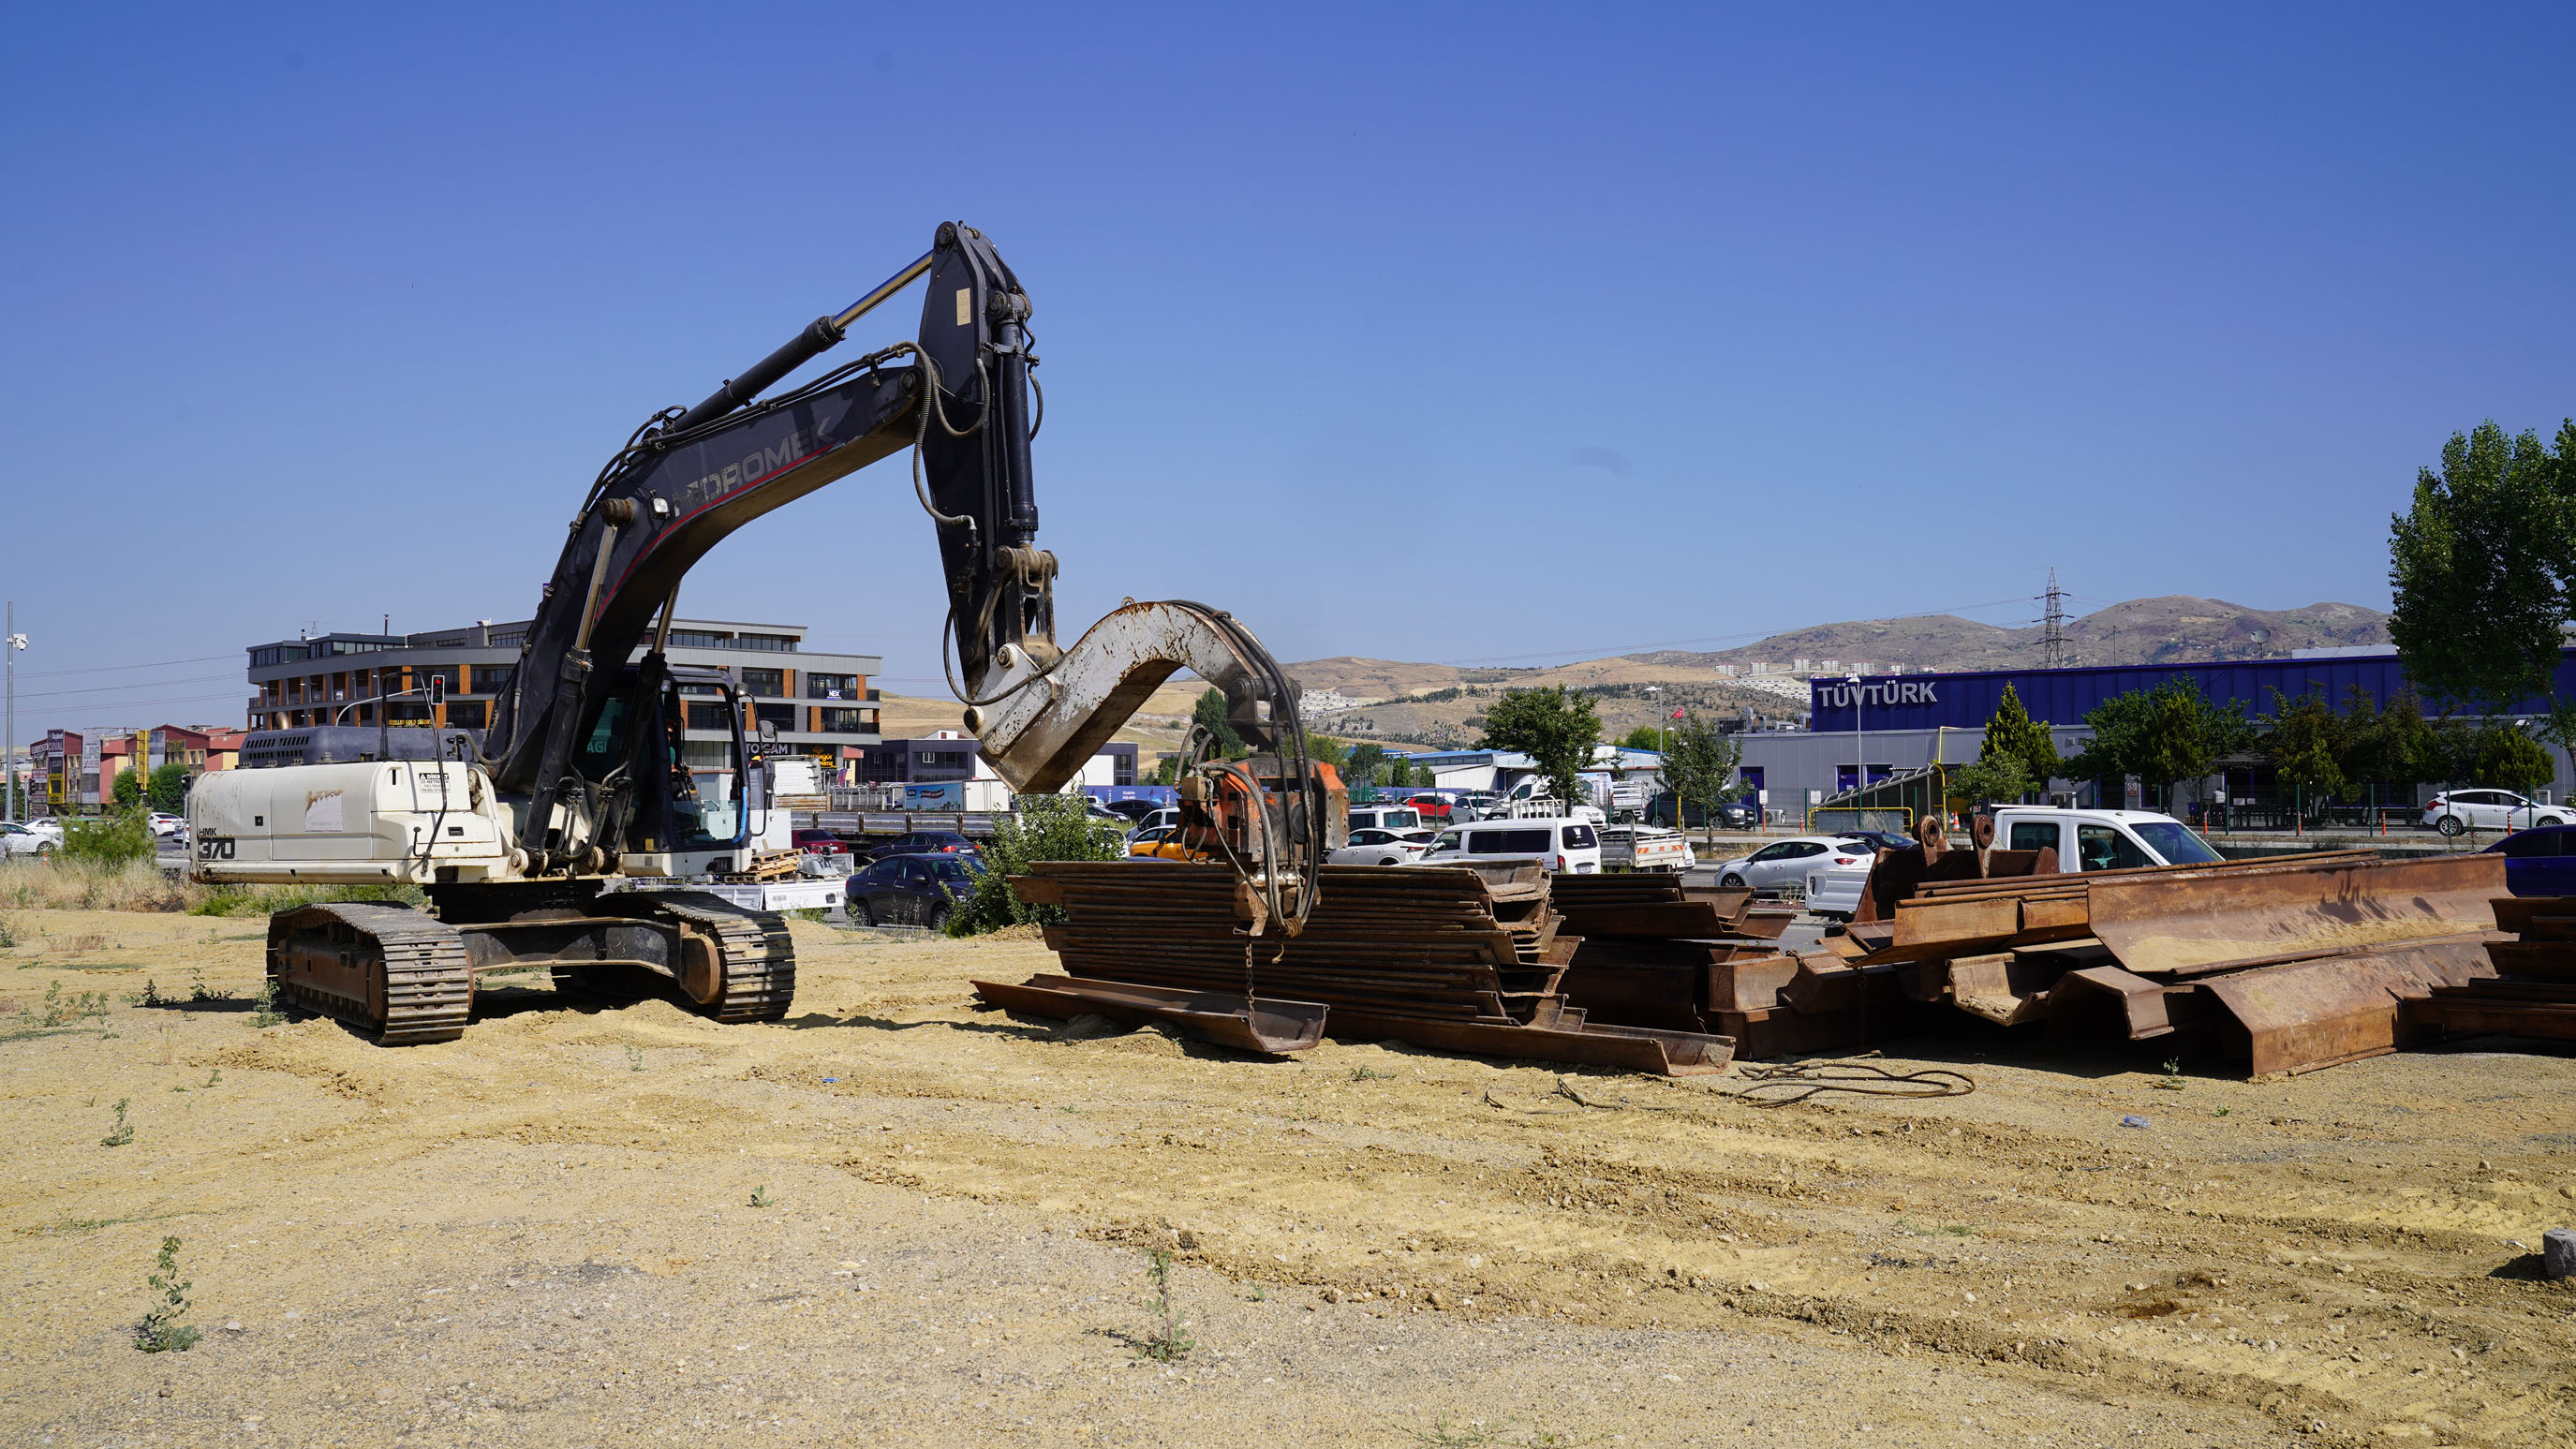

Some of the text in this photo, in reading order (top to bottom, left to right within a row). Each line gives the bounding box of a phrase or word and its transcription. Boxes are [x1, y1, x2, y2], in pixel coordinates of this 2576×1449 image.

[1817, 679, 1938, 707] TÜVTÜRK
[746, 743, 760, 754] TO
[199, 827, 217, 836] HMK
[198, 836, 236, 860] 370
